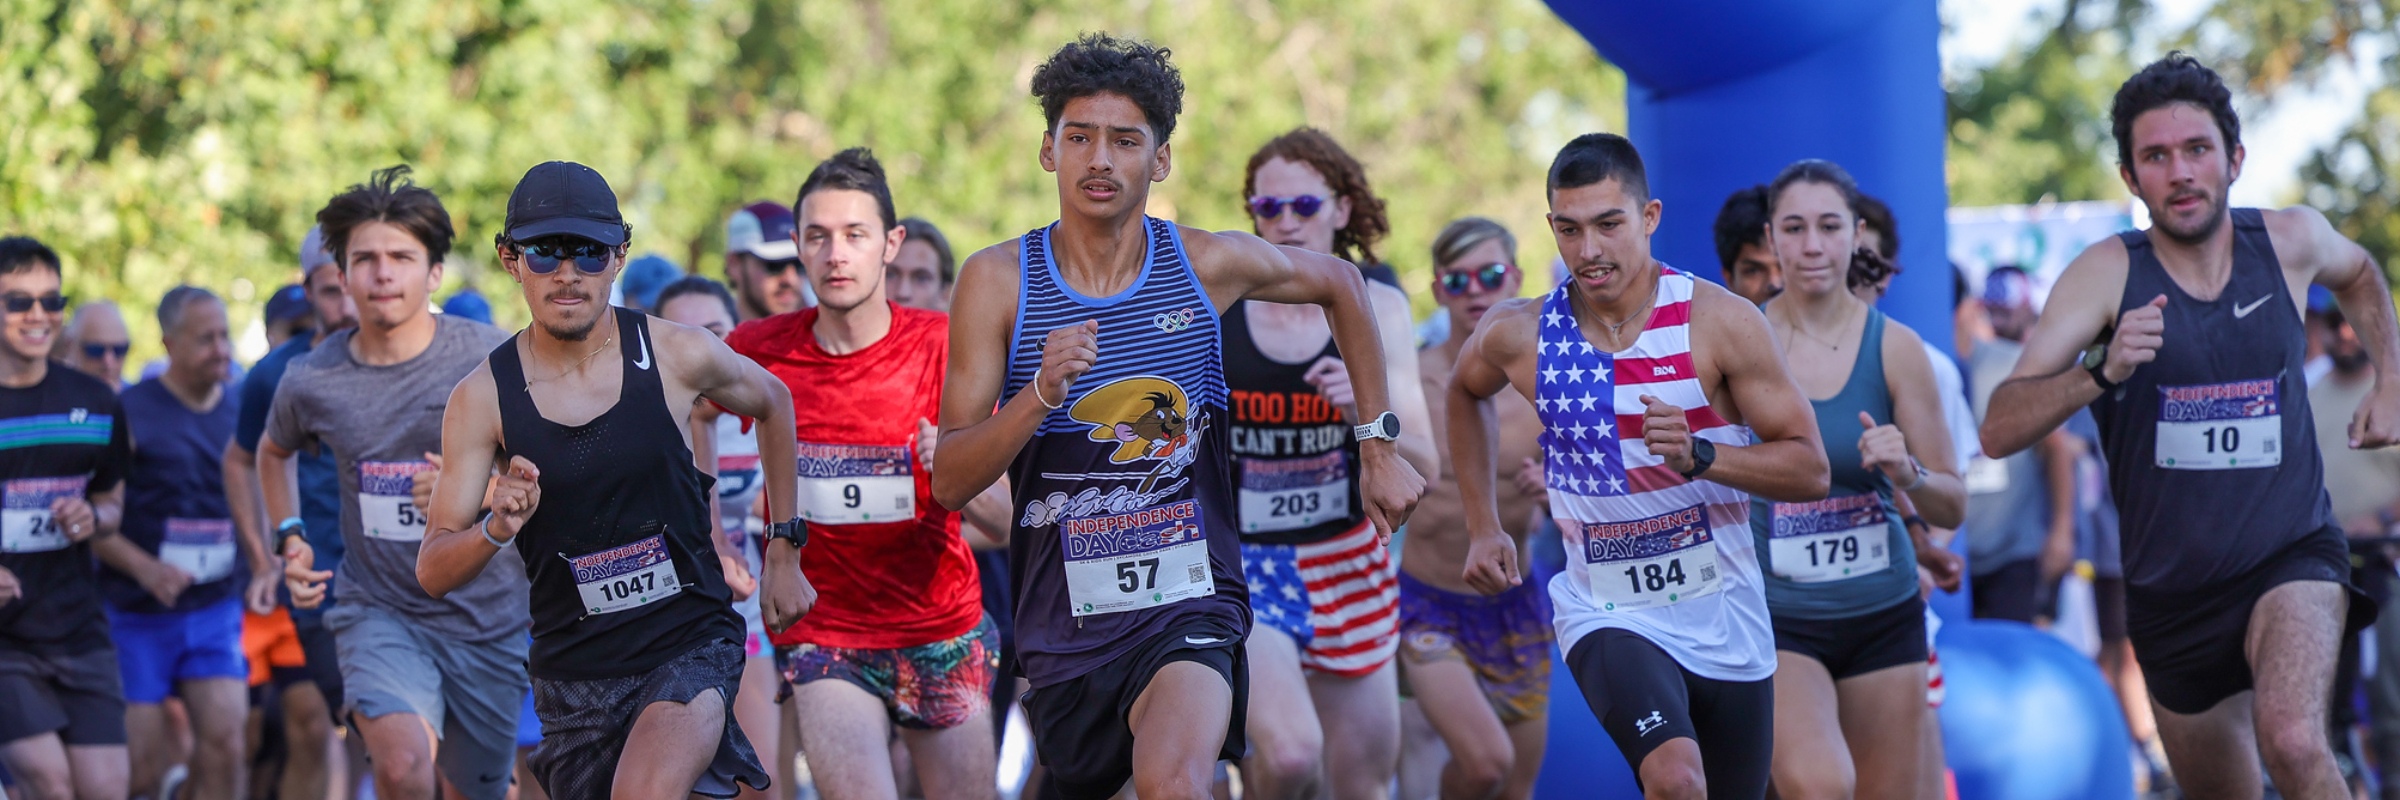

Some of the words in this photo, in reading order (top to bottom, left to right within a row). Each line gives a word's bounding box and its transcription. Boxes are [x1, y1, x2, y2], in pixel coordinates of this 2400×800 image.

[1231, 389, 1286, 423] TOO
[2164, 398, 2214, 420] DAY
[1230, 426, 1297, 455] CAN'T
[1299, 424, 1348, 454] RUN
[2203, 426, 2239, 454] 10
[797, 457, 842, 477] DAY
[843, 484, 861, 508] 9
[1271, 492, 1320, 517] 203
[1067, 502, 1195, 536] INDEPENDENCE
[1588, 507, 1701, 540] INDEPENDENCE
[1774, 510, 1821, 537] DAY
[575, 537, 661, 569] INDEPENDENCE
[1069, 529, 1123, 558] DAY
[1590, 536, 1637, 561] DAY
[1805, 536, 1858, 567] 179
[578, 561, 614, 583] DAY
[600, 571, 656, 602] 1047
[1116, 557, 1160, 593] 57
[1624, 558, 1687, 594] 184
